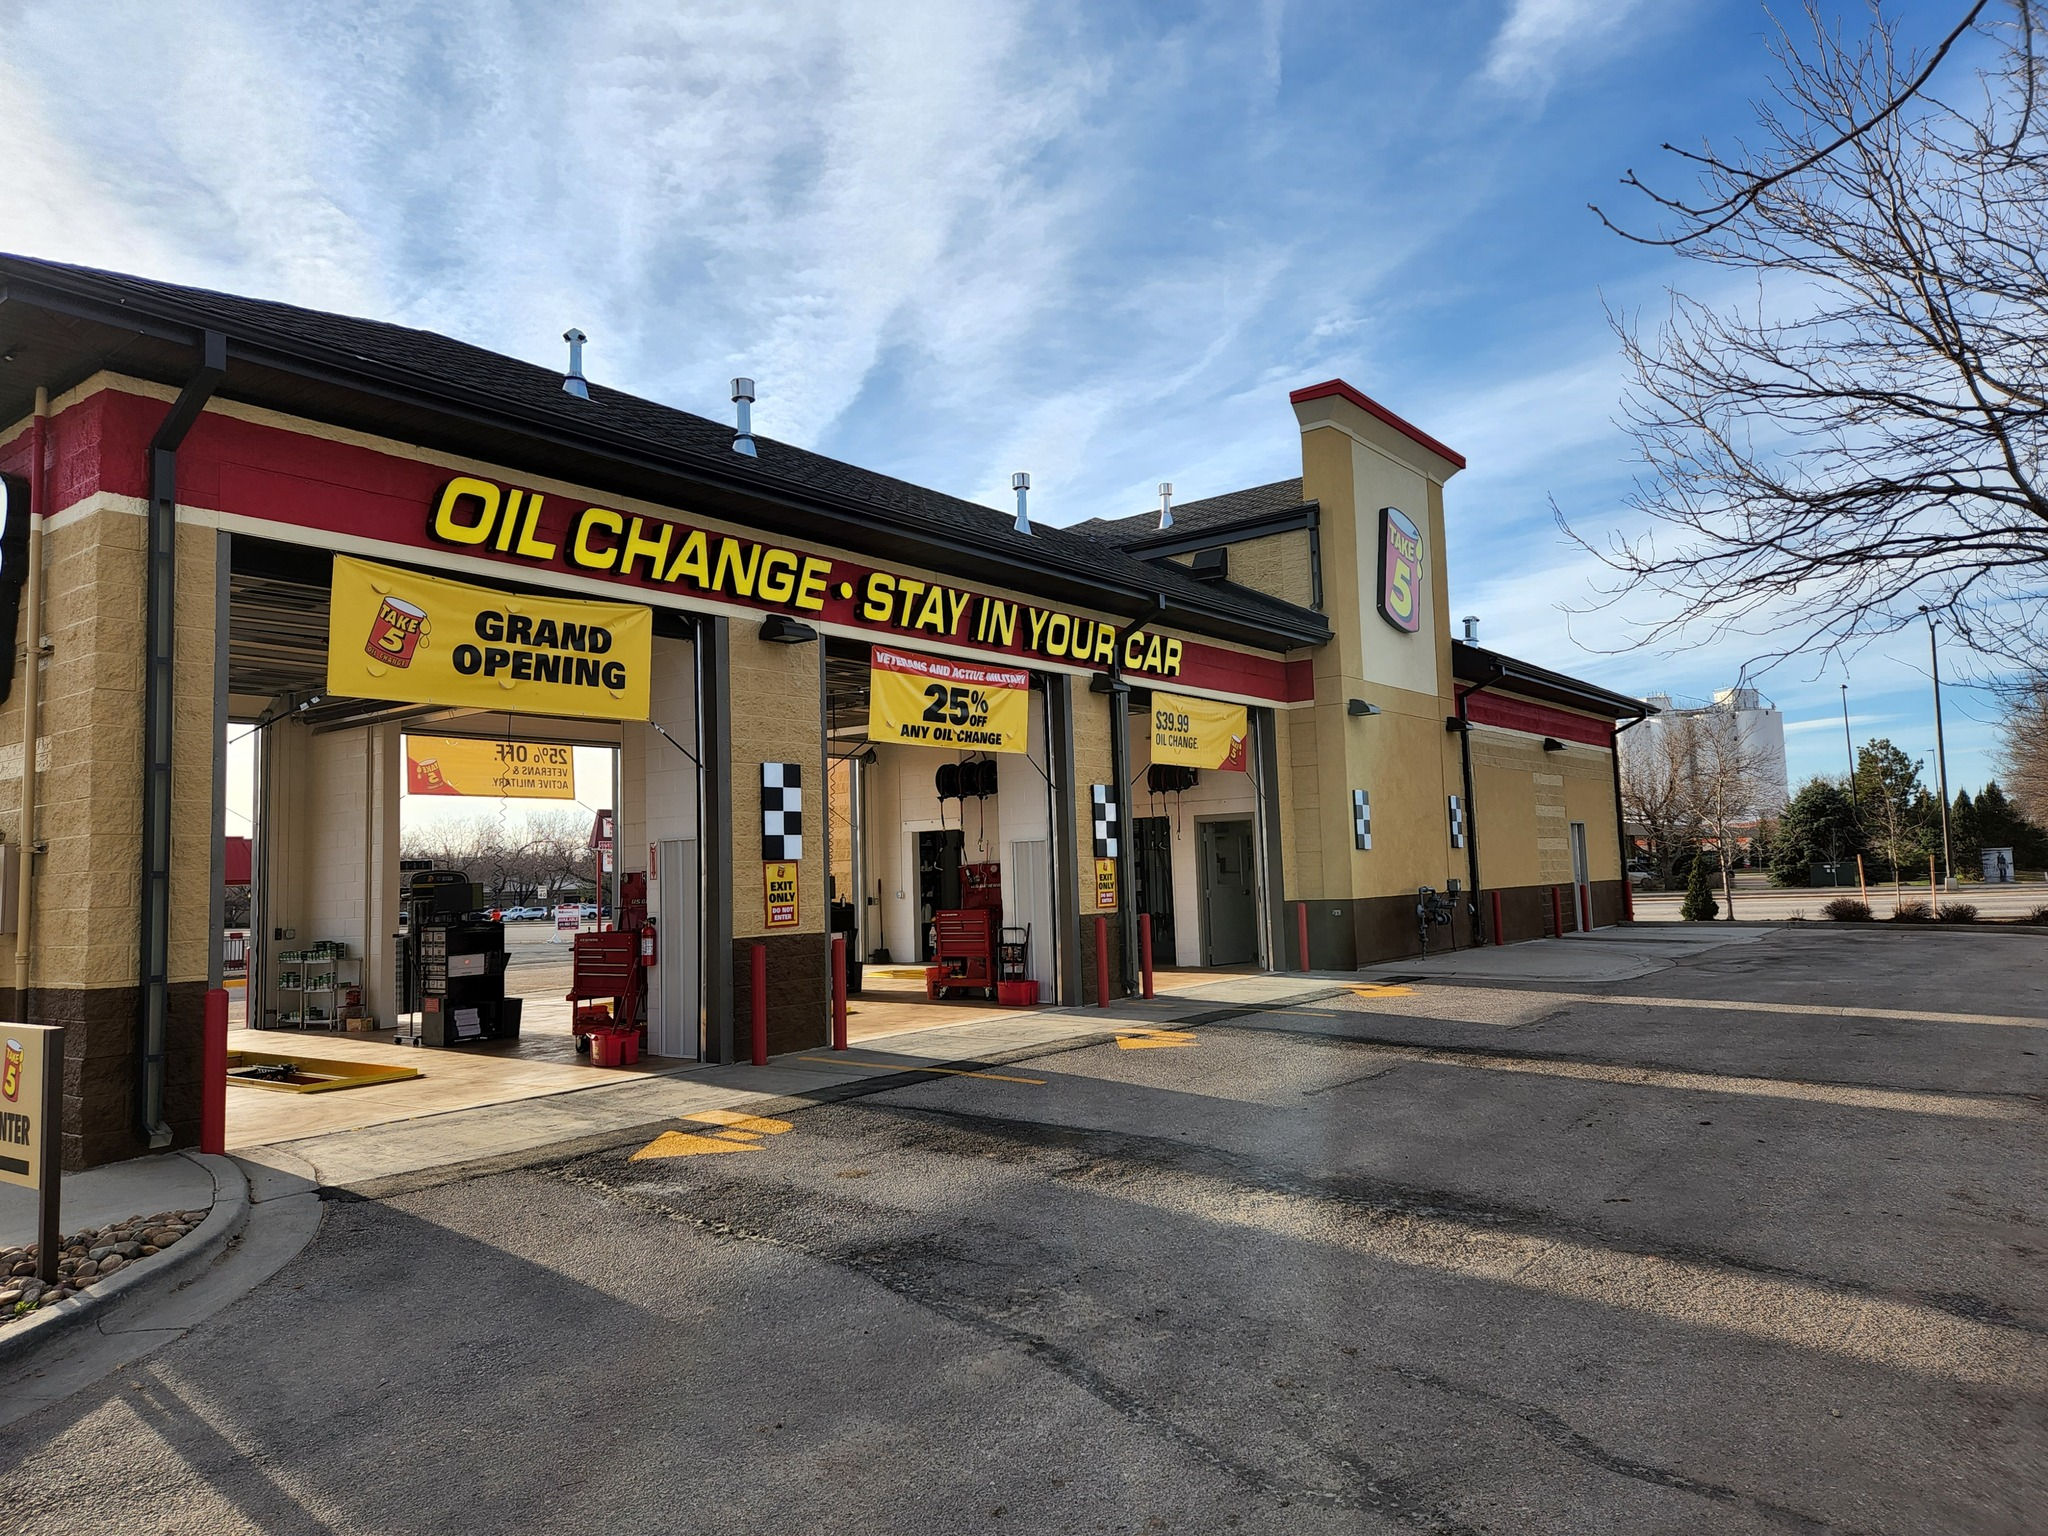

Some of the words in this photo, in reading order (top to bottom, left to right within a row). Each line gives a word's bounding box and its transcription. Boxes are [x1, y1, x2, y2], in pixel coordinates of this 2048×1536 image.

[1388, 523, 1415, 563] TAKE
[435, 477, 557, 560] OIL
[573, 507, 833, 612] CHANGE
[865, 573, 970, 635] STAY
[977, 597, 1018, 647] IN
[1030, 609, 1116, 665] YOUR
[1124, 630, 1183, 677] CAR
[1389, 557, 1413, 621] 5
[380, 604, 419, 634] TAKE
[378, 627, 406, 654] 5
[475, 610, 612, 654] GRAND
[452, 644, 626, 689] OPENING
[876, 652, 927, 672] VETERANS
[929, 663, 950, 676] AND
[952, 667, 984, 681] ACTIVE
[985, 673, 1026, 684] MILITARY
[923, 683, 989, 726] 25%
[969, 714, 988, 727] OFF
[1156, 710, 1189, 733] $39.99
[900, 724, 930, 739] ANY
[933, 727, 953, 741] OIL
[957, 729, 1002, 745] CHANGE
[1156, 733, 1167, 746] OIL
[770, 881, 794, 891] EXIT
[1099, 873, 1113, 881] EXIT
[1099, 882, 1114, 890] ONLY
[768, 892, 795, 903] ONLY
[774, 913, 792, 921] ENTER
[6, 1047, 20, 1064] TAKE
[4, 1064, 16, 1096] 5
